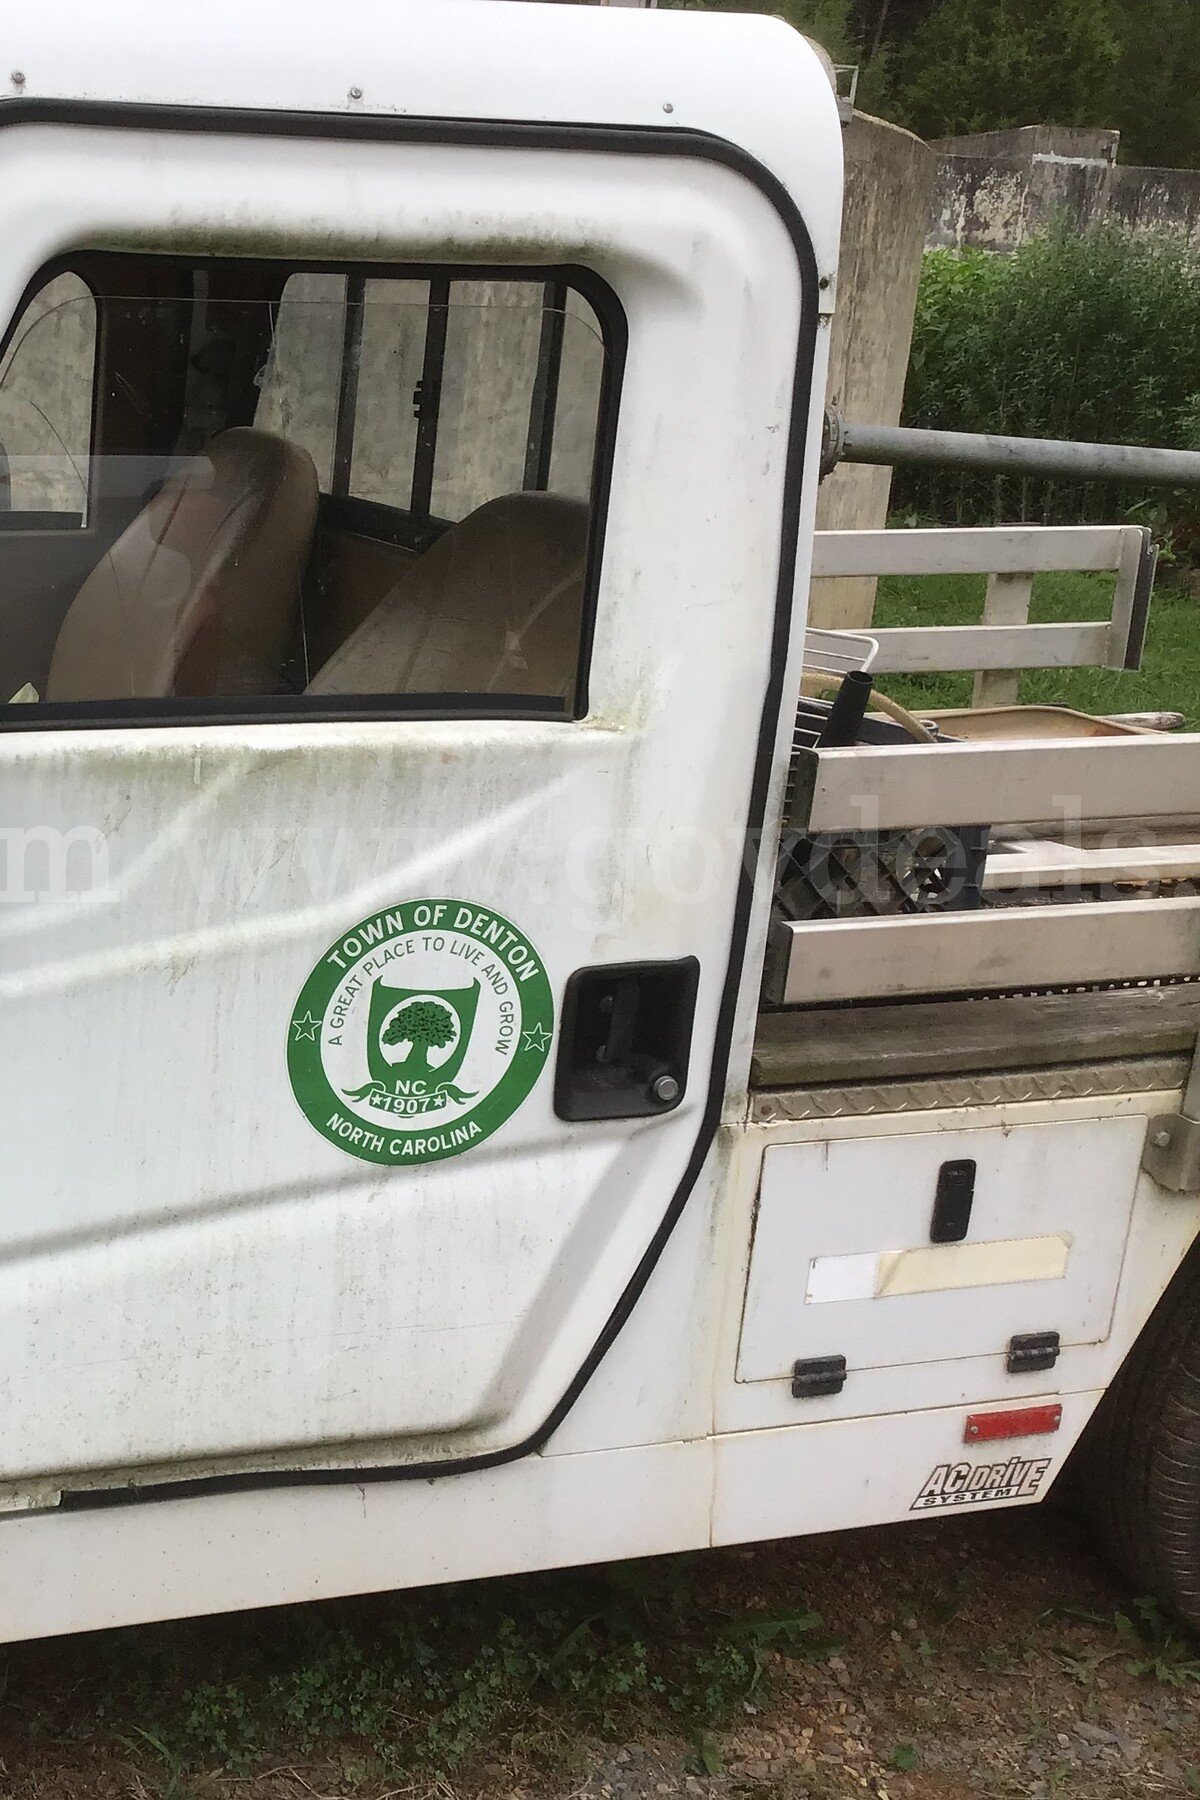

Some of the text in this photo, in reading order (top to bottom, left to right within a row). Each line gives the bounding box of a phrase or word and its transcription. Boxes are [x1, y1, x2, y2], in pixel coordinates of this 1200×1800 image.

[327, 904, 539, 982] TOWN OF DENTON
[328, 936, 515, 1055] A GREAT PLACE TO LIVE AND GROW
[395, 1080, 427, 1095] NC
[383, 1097, 431, 1113] 1907
[326, 1112, 482, 1156] NORTH CAROLINA
[922, 1489, 1013, 1507] SYSTEM
